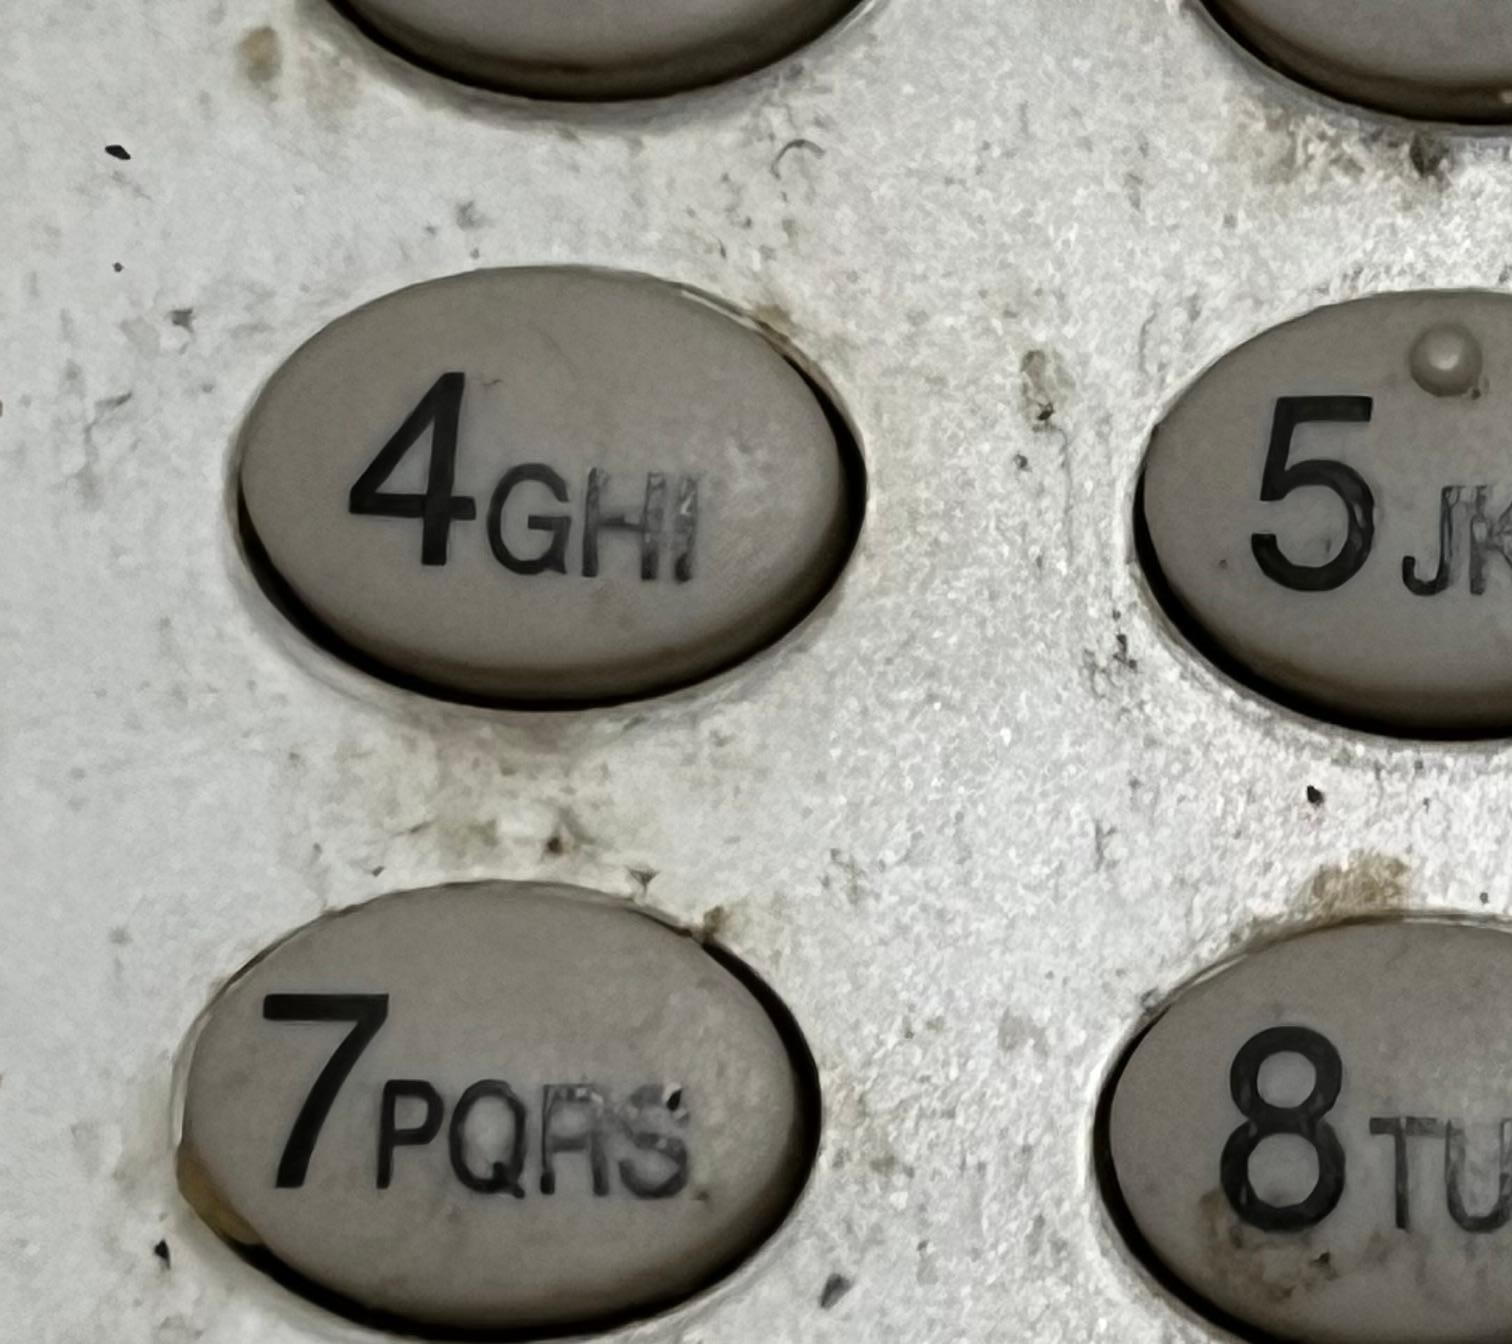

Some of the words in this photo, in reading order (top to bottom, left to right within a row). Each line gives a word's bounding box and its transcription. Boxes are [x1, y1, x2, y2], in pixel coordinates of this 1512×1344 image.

[347, 371, 477, 567] 4
[1249, 395, 1378, 593] 5
[262, 992, 390, 1190] 7
[1219, 1024, 1347, 1234] 8
